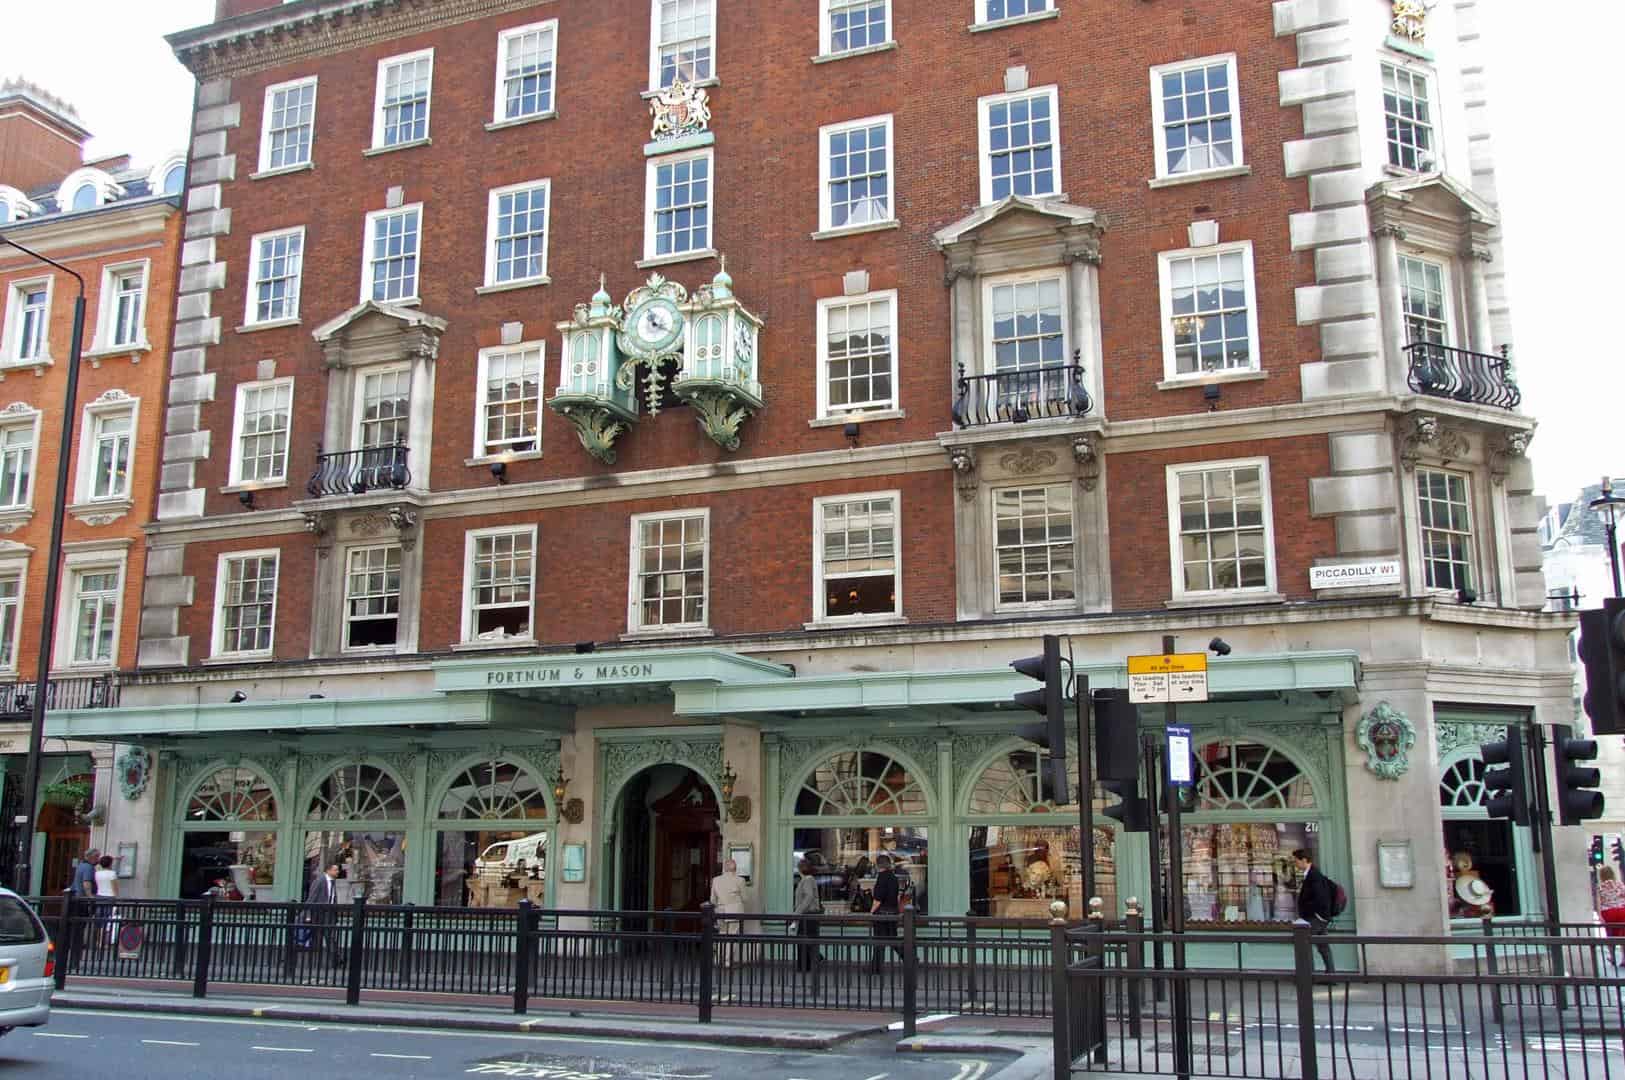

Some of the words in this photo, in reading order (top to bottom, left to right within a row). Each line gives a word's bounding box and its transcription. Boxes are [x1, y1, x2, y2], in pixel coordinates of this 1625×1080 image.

[1315, 566, 1377, 578] PICCADILLY
[1380, 565, 1395, 574] W1
[487, 669, 561, 685] FORTNUM
[573, 667, 584, 680] &
[596, 663, 653, 680] MASON
